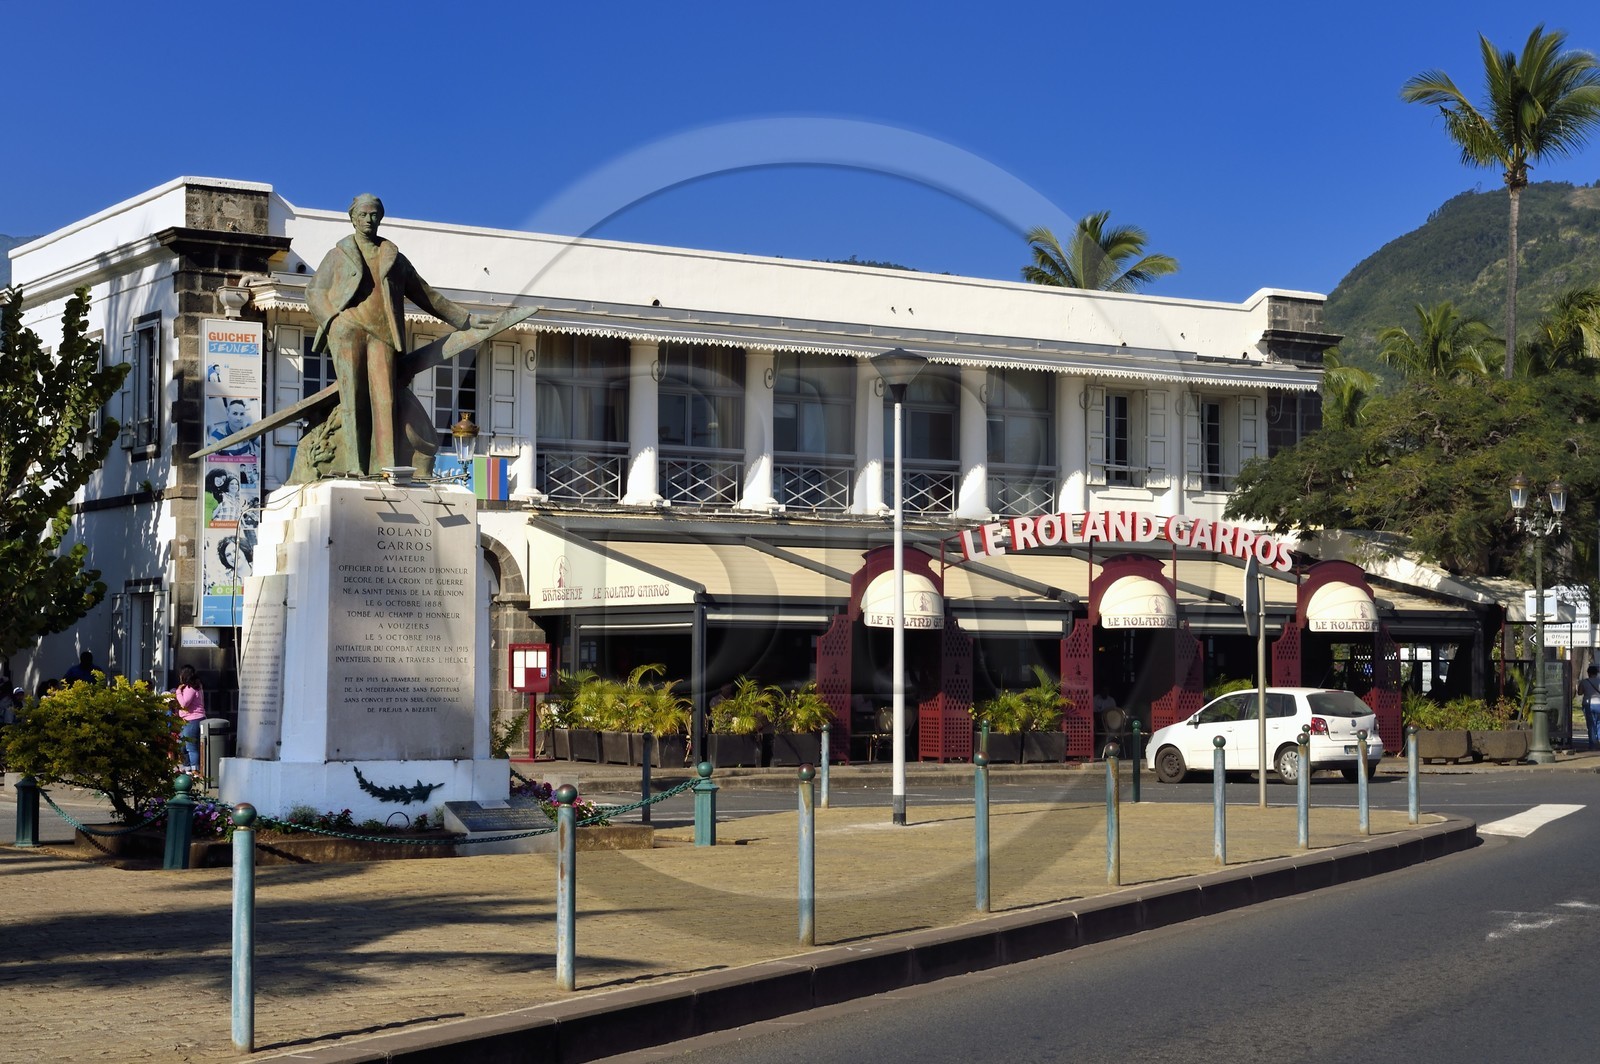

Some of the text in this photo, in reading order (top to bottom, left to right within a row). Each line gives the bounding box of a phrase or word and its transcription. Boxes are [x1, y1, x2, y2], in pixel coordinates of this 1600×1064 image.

[208, 332, 256, 343] GUICHET
[210, 343, 256, 353] JEUNES
[377, 527, 432, 537] ROLAND
[377, 541, 432, 551] GARROS
[959, 510, 1295, 572] LE ROLAND GARROS
[542, 584, 669, 601] BRASSERIE LE ROLAND GARROS
[871, 615, 883, 625] LE
[886, 616, 931, 627] RLAND
[1108, 618, 1120, 626] LE
[1123, 617, 1165, 626] ROLAND
[1315, 621, 1327, 629] LE
[1330, 621, 1370, 630] ROLAND
